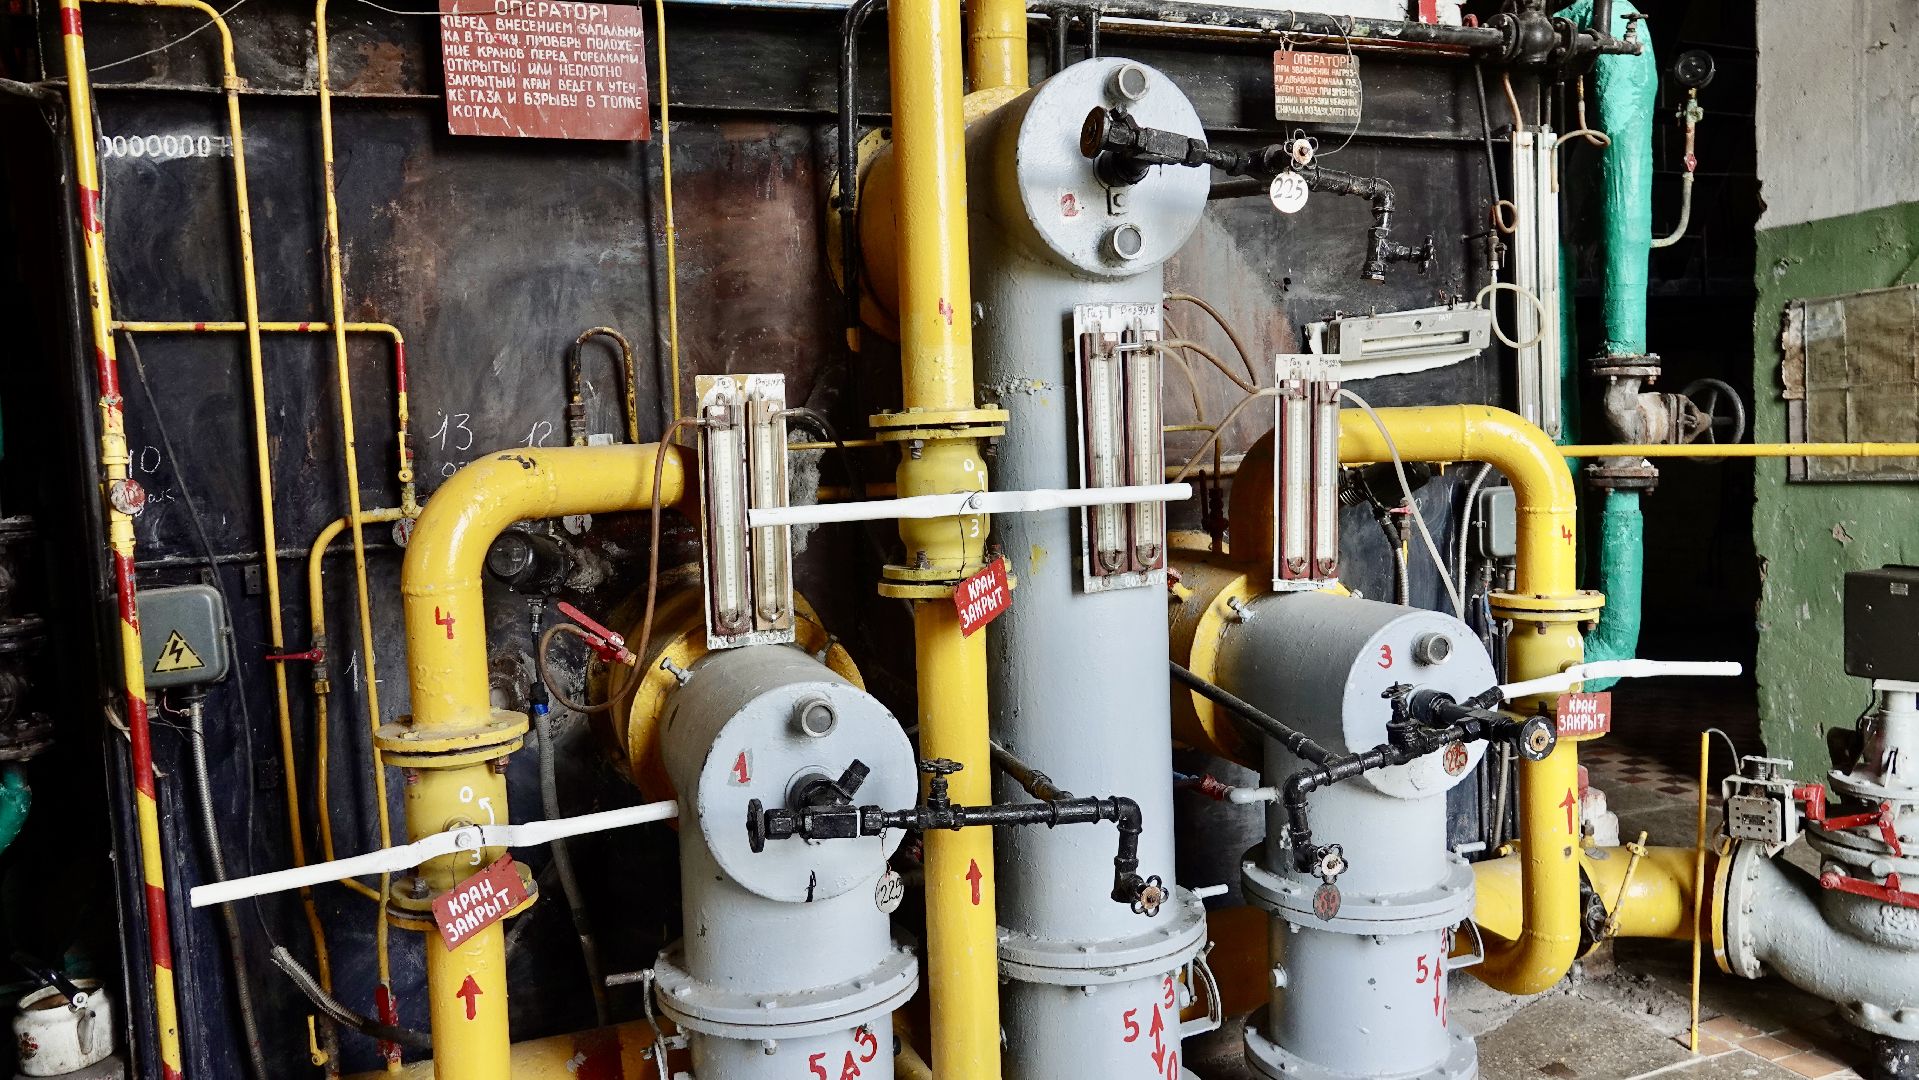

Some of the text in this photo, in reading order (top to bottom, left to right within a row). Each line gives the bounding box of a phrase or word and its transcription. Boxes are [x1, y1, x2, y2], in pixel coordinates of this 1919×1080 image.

[495, 0, 608, 22] ОПЕРАТОР!
[443, 15, 488, 31] ПЕРЕД
[495, 18, 573, 34] ВНЕСЕНИЕМ
[444, 30, 460, 42] КА
[464, 30, 474, 43] В
[525, 35, 582, 49] ПРОВЕРЬ
[444, 44, 471, 57] НИЕ
[477, 46, 525, 58] КРАНОВ
[530, 48, 568, 63] ПЕРЕД
[446, 58, 622, 78] ОТКРЫТЫЙ ИЛИ НЕПЛОТНО
[447, 73, 516, 89] ЗАКРЫТЫЙ
[522, 77, 551, 90] КРАН
[558, 78, 592, 92] ВЕДЕТ
[596, 80, 605, 92] К
[447, 88, 643, 109] КЕ ГАЗА И ВЗРЫВУ В ТОПКЕ
[452, 104, 503, 119] КОТЛА
[1273, 177, 1304, 200] 225
[1060, 193, 1079, 217] 2
[429, 413, 473, 451] 13
[1561, 524, 1573, 546] 4
[967, 570, 996, 602] КРАН
[960, 585, 1003, 629] ЗАКРЫТ
[434, 605, 456, 640] 4
[1377, 644, 1393, 670] 3
[1568, 697, 1598, 714] КРАН
[1558, 713, 1606, 731] ЗАКРЫТ
[732, 751, 751, 784] 1
[447, 878, 494, 917] КРАН
[445, 887, 509, 942] ЗАКРЫТ
[1416, 954, 1429, 984] 5
[1123, 1007, 1140, 1043] 5
